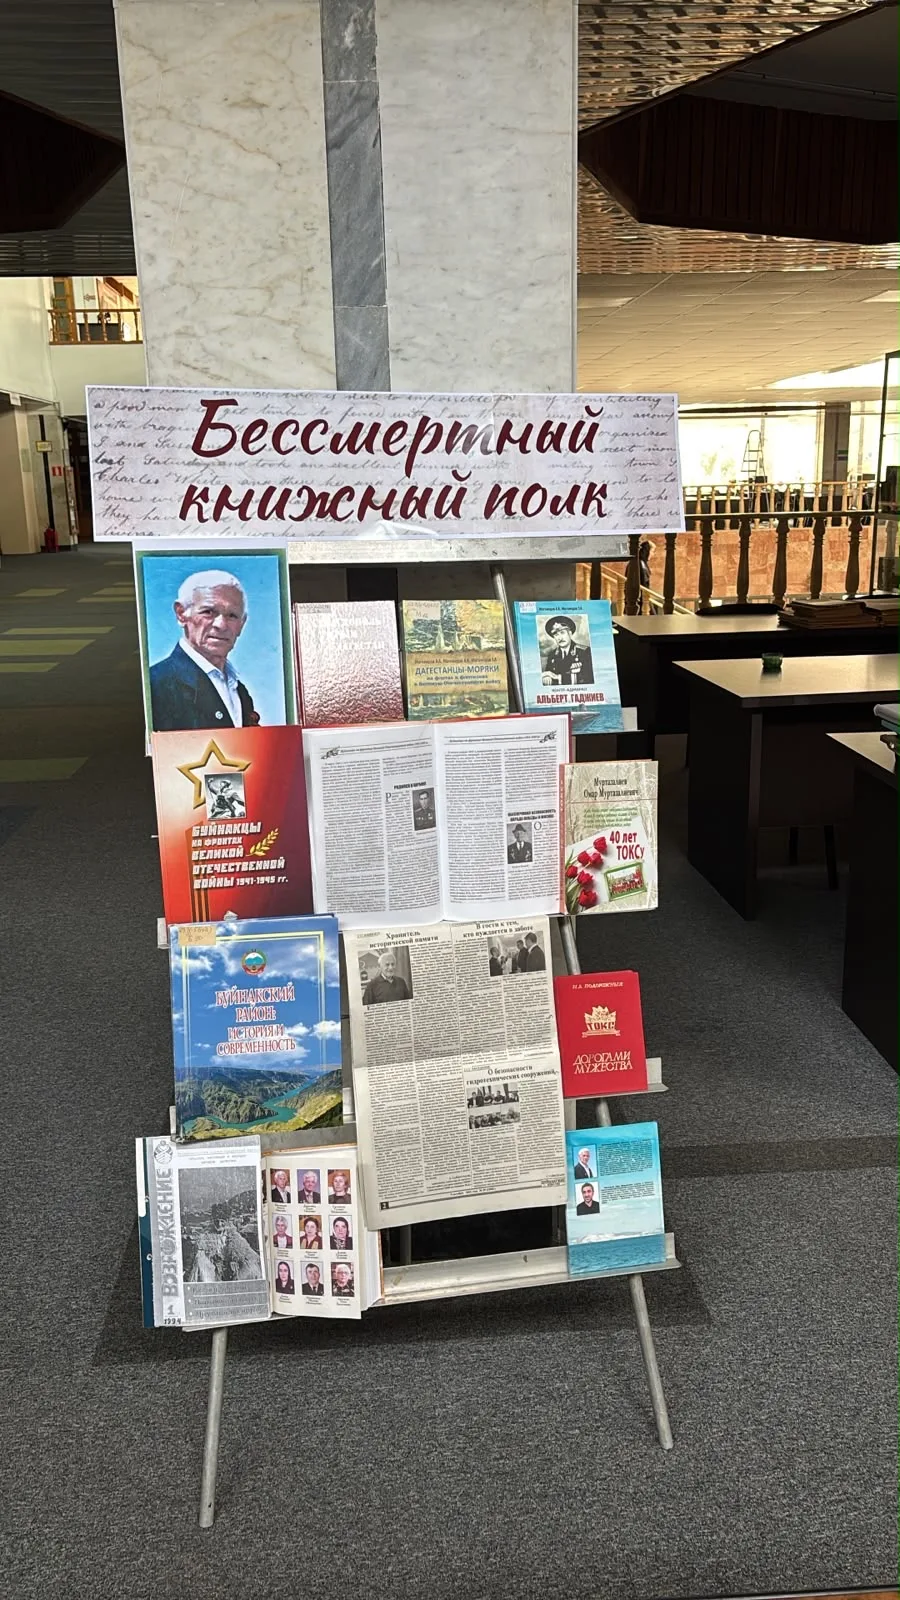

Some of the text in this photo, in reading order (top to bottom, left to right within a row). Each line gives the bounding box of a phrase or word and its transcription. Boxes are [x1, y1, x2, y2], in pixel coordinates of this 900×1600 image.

[191, 398, 604, 479] Бессмертный
[179, 469, 609, 523] книжный полк
[415, 664, 499, 676] ДАГЕСТАНЦЫ-МОРЯКИ
[536, 692, 605, 704] АЛЬБЕРТ ГАДЖИЕВ
[583, 789, 598, 801] Омар
[192, 821, 262, 837] БУЙНАКЦЫ
[191, 836, 243, 848] НА ФРОНТАХ
[609, 831, 638, 845] 40 лет
[191, 845, 244, 861] ВЕЛИКОЙ
[616, 844, 646, 861] ТОКСу
[192, 857, 286, 875] ОТЕЧЕСТВЕННОЙ
[193, 875, 234, 889] ВОЙНЫ
[236, 875, 276, 886] 1941-1945
[385, 931, 421, 940] Хранитель
[369, 938, 414, 949] исторической
[215, 981, 295, 1008] БУЙНАКСКИЙ
[236, 1003, 277, 1023] РАЙОН:
[227, 1024, 285, 1042] ИСТОРИЯ И
[587, 1021, 615, 1031] ТОКС
[216, 1038, 296, 1057] СОВРЕМЕННОСТЬ
[573, 1050, 632, 1066] ДОРОГАМИ
[494, 1064, 533, 1075] безопасности
[574, 1060, 634, 1075] МУЖЕСТВА
[466, 1073, 520, 1086] гидротехнических
[167, 1304, 175, 1315] 1
